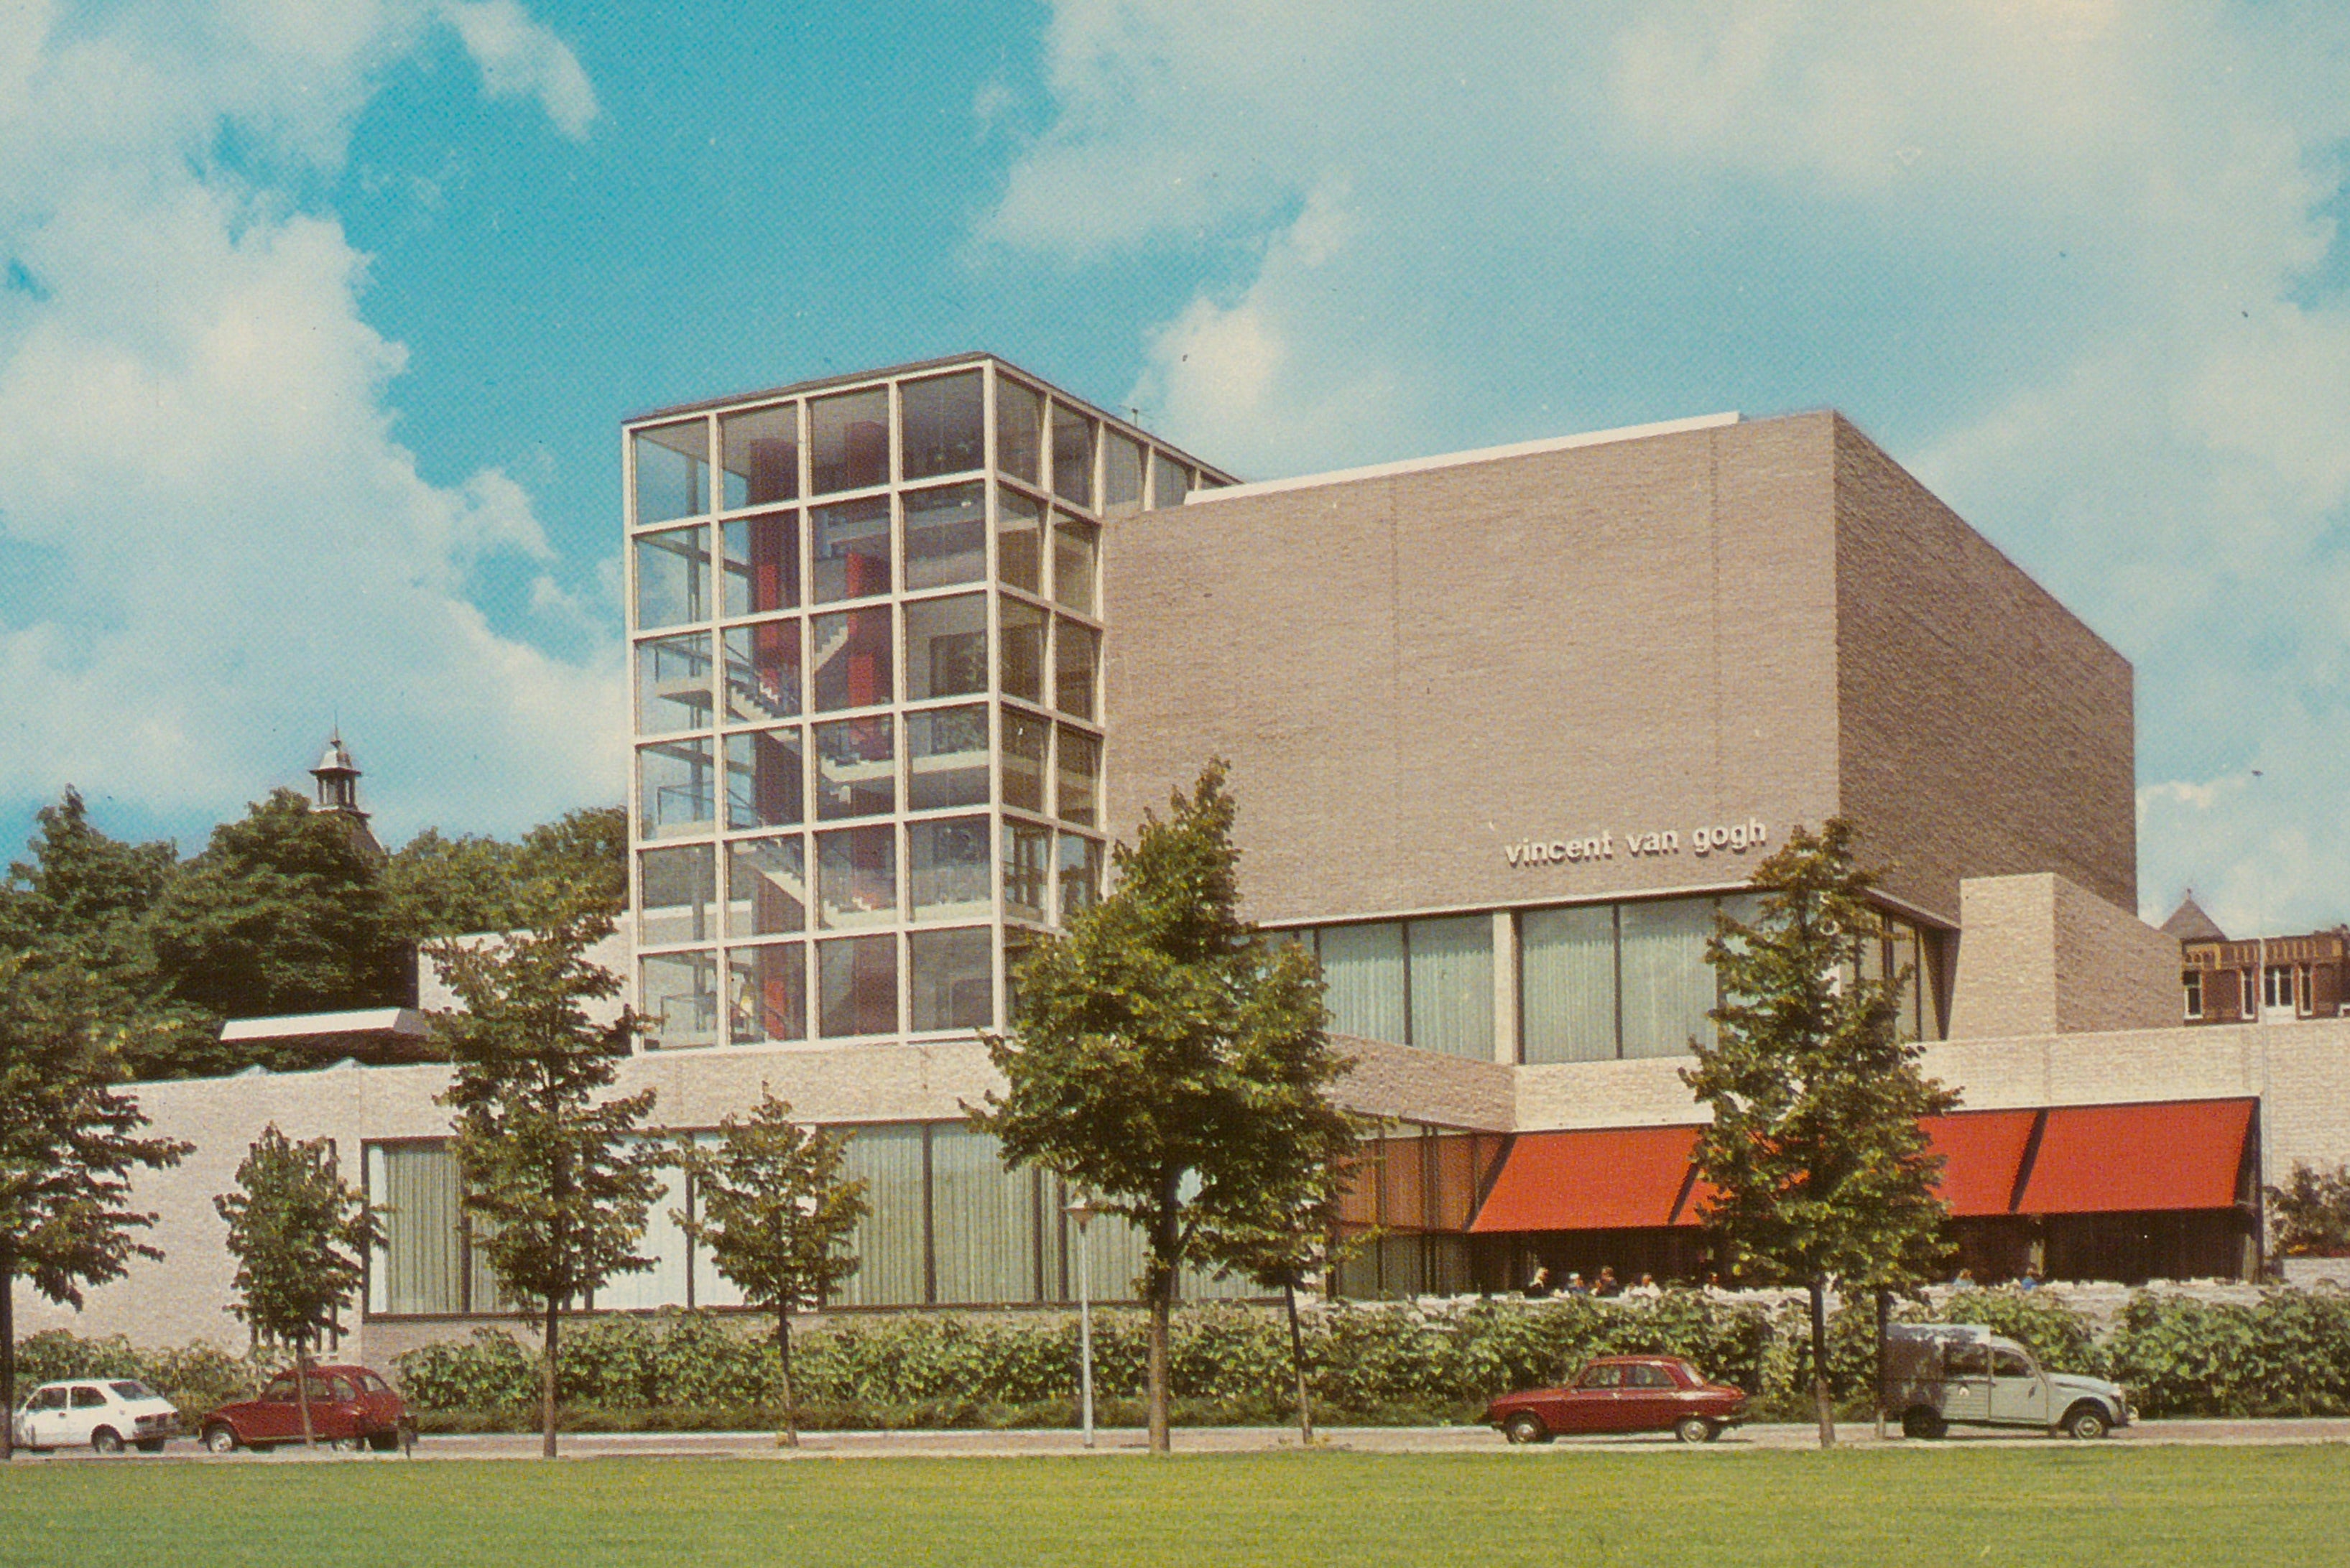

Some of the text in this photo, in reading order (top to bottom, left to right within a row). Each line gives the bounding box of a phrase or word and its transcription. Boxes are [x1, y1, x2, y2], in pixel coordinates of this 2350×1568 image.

[1505, 816, 1767, 865] vincent van gogh
